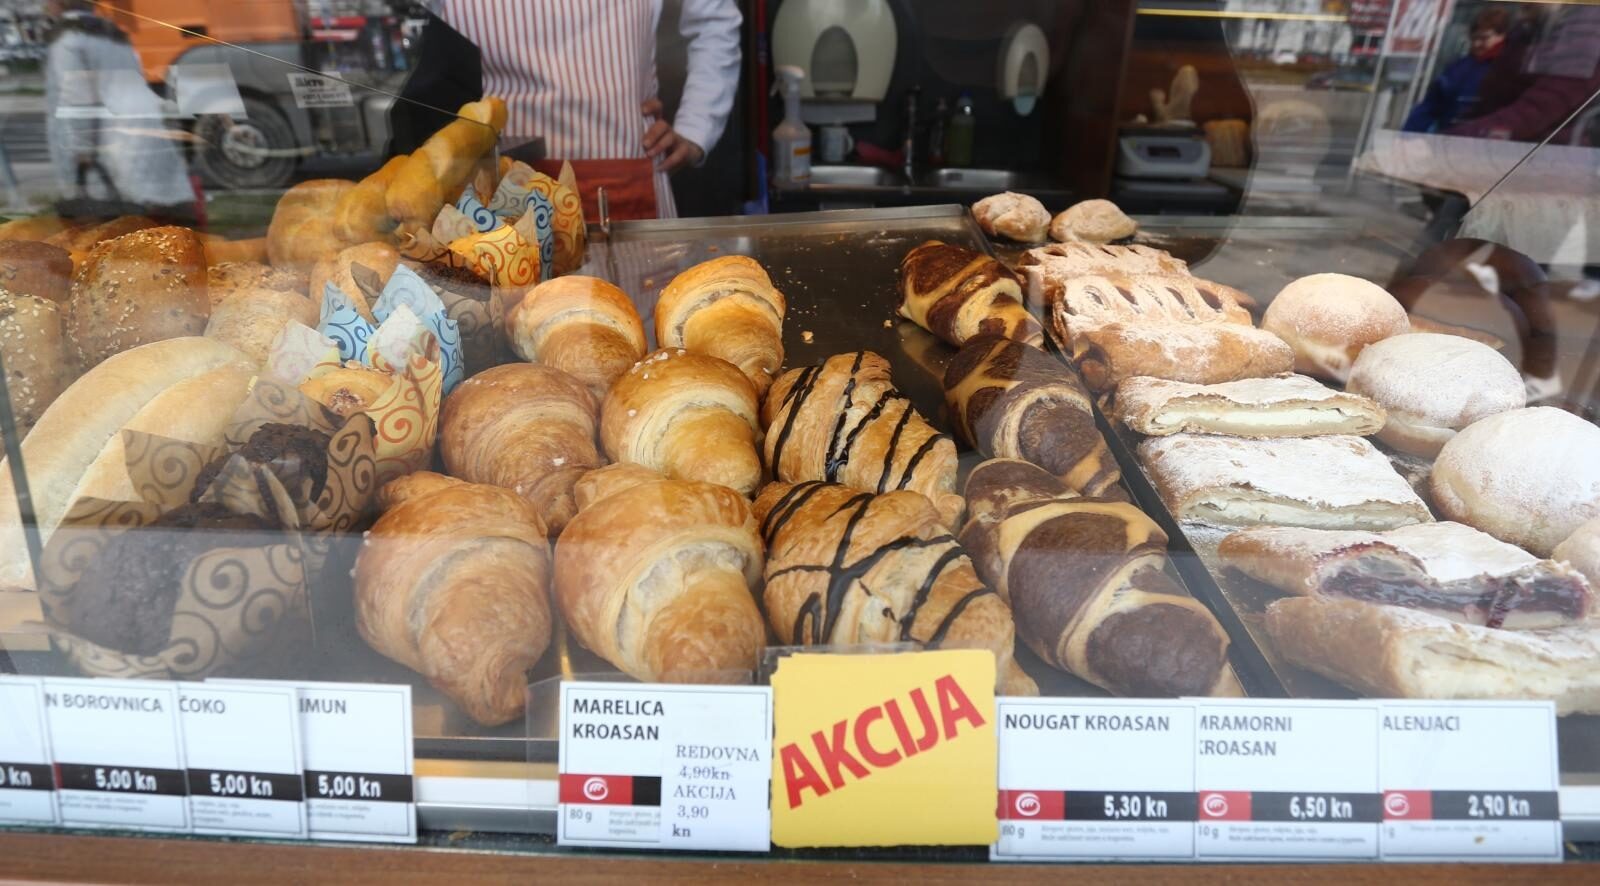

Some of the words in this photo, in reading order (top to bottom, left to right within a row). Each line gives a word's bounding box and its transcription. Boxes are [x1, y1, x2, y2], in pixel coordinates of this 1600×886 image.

[62, 693, 164, 713] BOROVNICA
[572, 697, 665, 717] MARELICA
[572, 722, 660, 742] KROASAN
[1004, 713, 1080, 731] NOUGAT
[1085, 714, 1170, 732] KROASAN
[779, 674, 986, 809] AKCIJA
[676, 744, 760, 762] REDOVNA
[7, 766, 32, 786] kn
[95, 767, 132, 791] 5,00
[133, 769, 157, 792] kn
[210, 772, 247, 796] 5,00
[249, 774, 273, 796] kn
[317, 774, 355, 799] 5,00
[358, 776, 382, 798] kn
[673, 784, 737, 801] AKCIJA
[569, 808, 583, 820] 80
[585, 811, 593, 824] g
[677, 804, 709, 820] 3,90
[1104, 794, 1141, 819] 5,30
[1145, 795, 1168, 818] kn
[1289, 795, 1327, 819] 6,50
[1330, 796, 1353, 819] kn
[1467, 795, 1506, 819] 2,90
[1508, 796, 1531, 818] kn
[672, 823, 692, 838] kn
